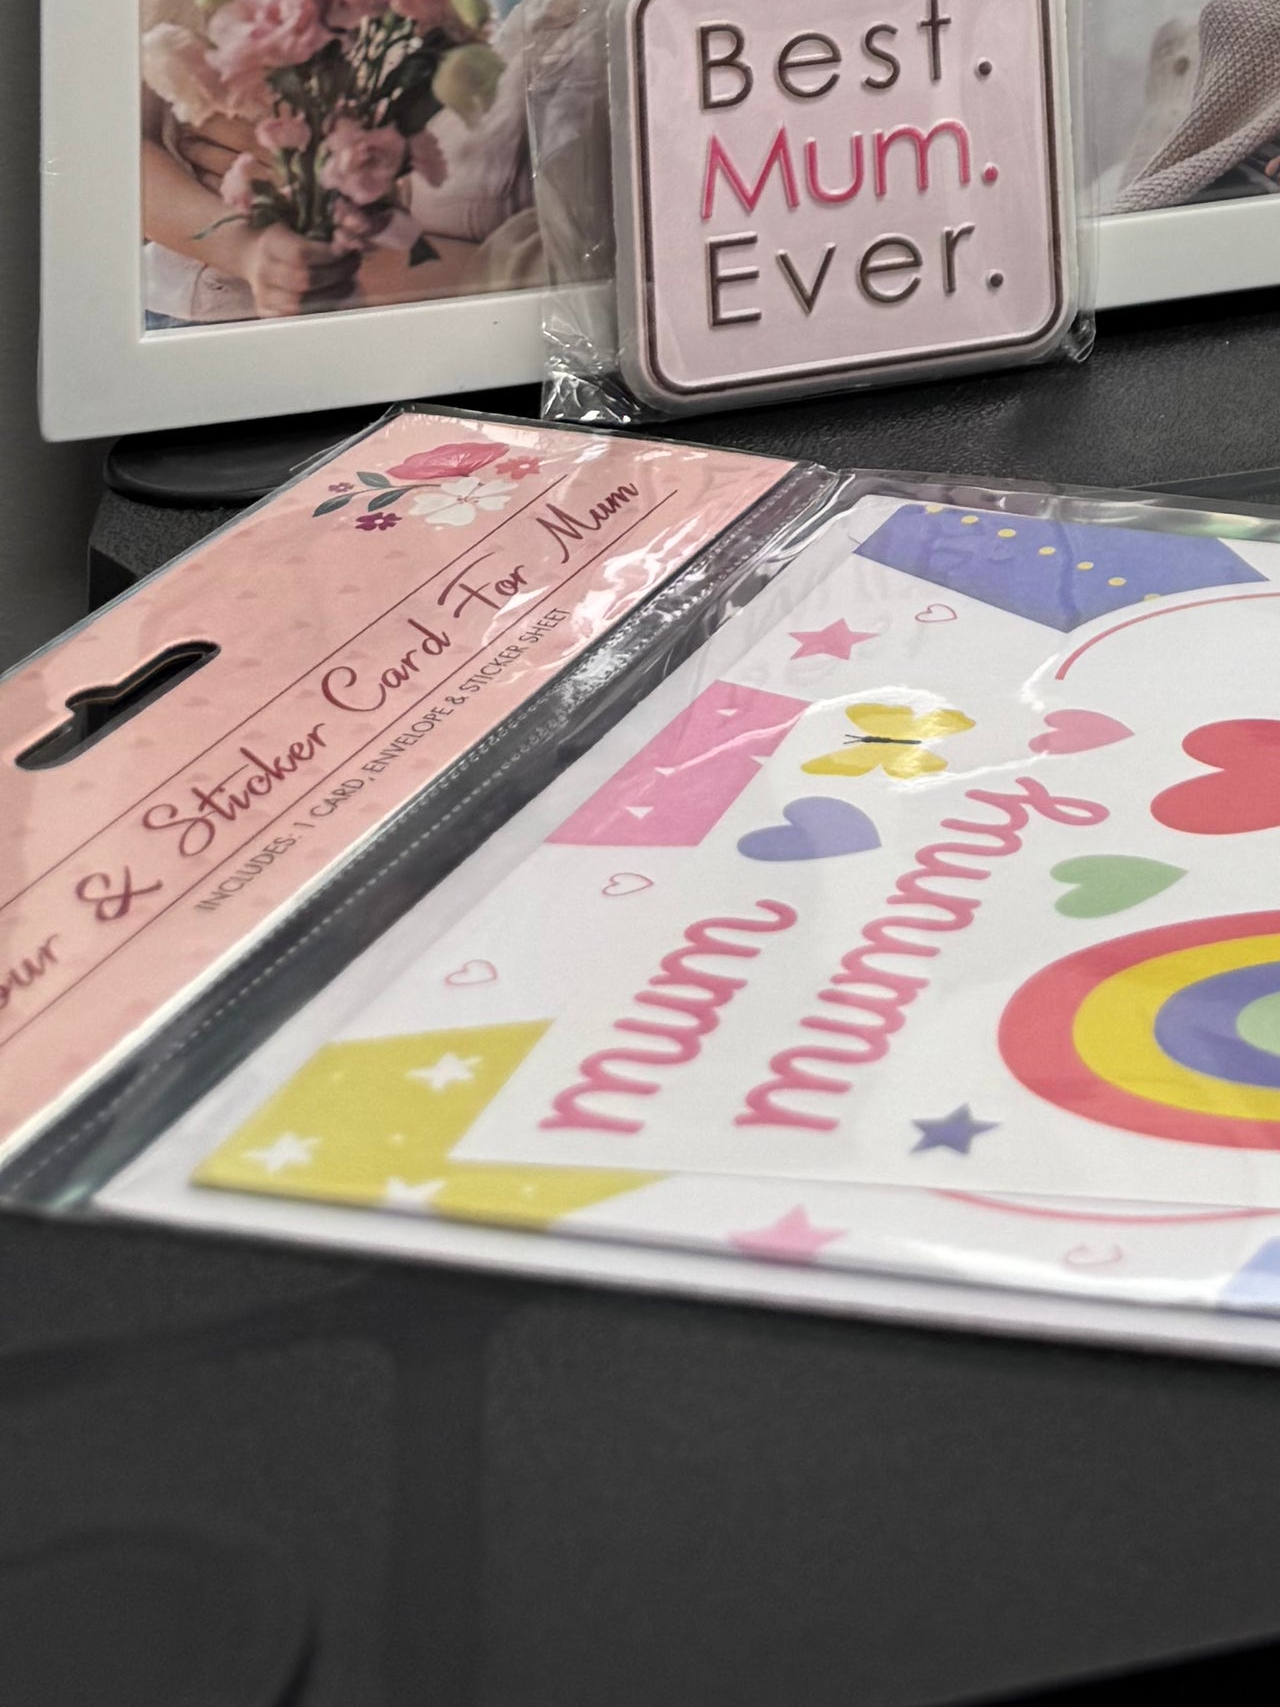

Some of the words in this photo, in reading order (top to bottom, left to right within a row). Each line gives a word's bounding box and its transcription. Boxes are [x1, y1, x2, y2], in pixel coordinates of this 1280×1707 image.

[701, 119, 999, 220] Mum.
[706, 222, 1004, 328] Ever.
[75, 865, 163, 924] &
[143, 720, 329, 858] Sticker
[320, 618, 452, 714] Card
[437, 550, 529, 620] For
[537, 477, 640, 565] Mum
[195, 832, 303, 913] INCLUDES:
[361, 702, 454, 777] ENVELOPE
[444, 693, 469, 706] &
[459, 644, 528, 695] STICKER
[518, 607, 571, 645] SHEET
[538, 899, 797, 1134] mum
[733, 775, 1110, 1132] mummy
